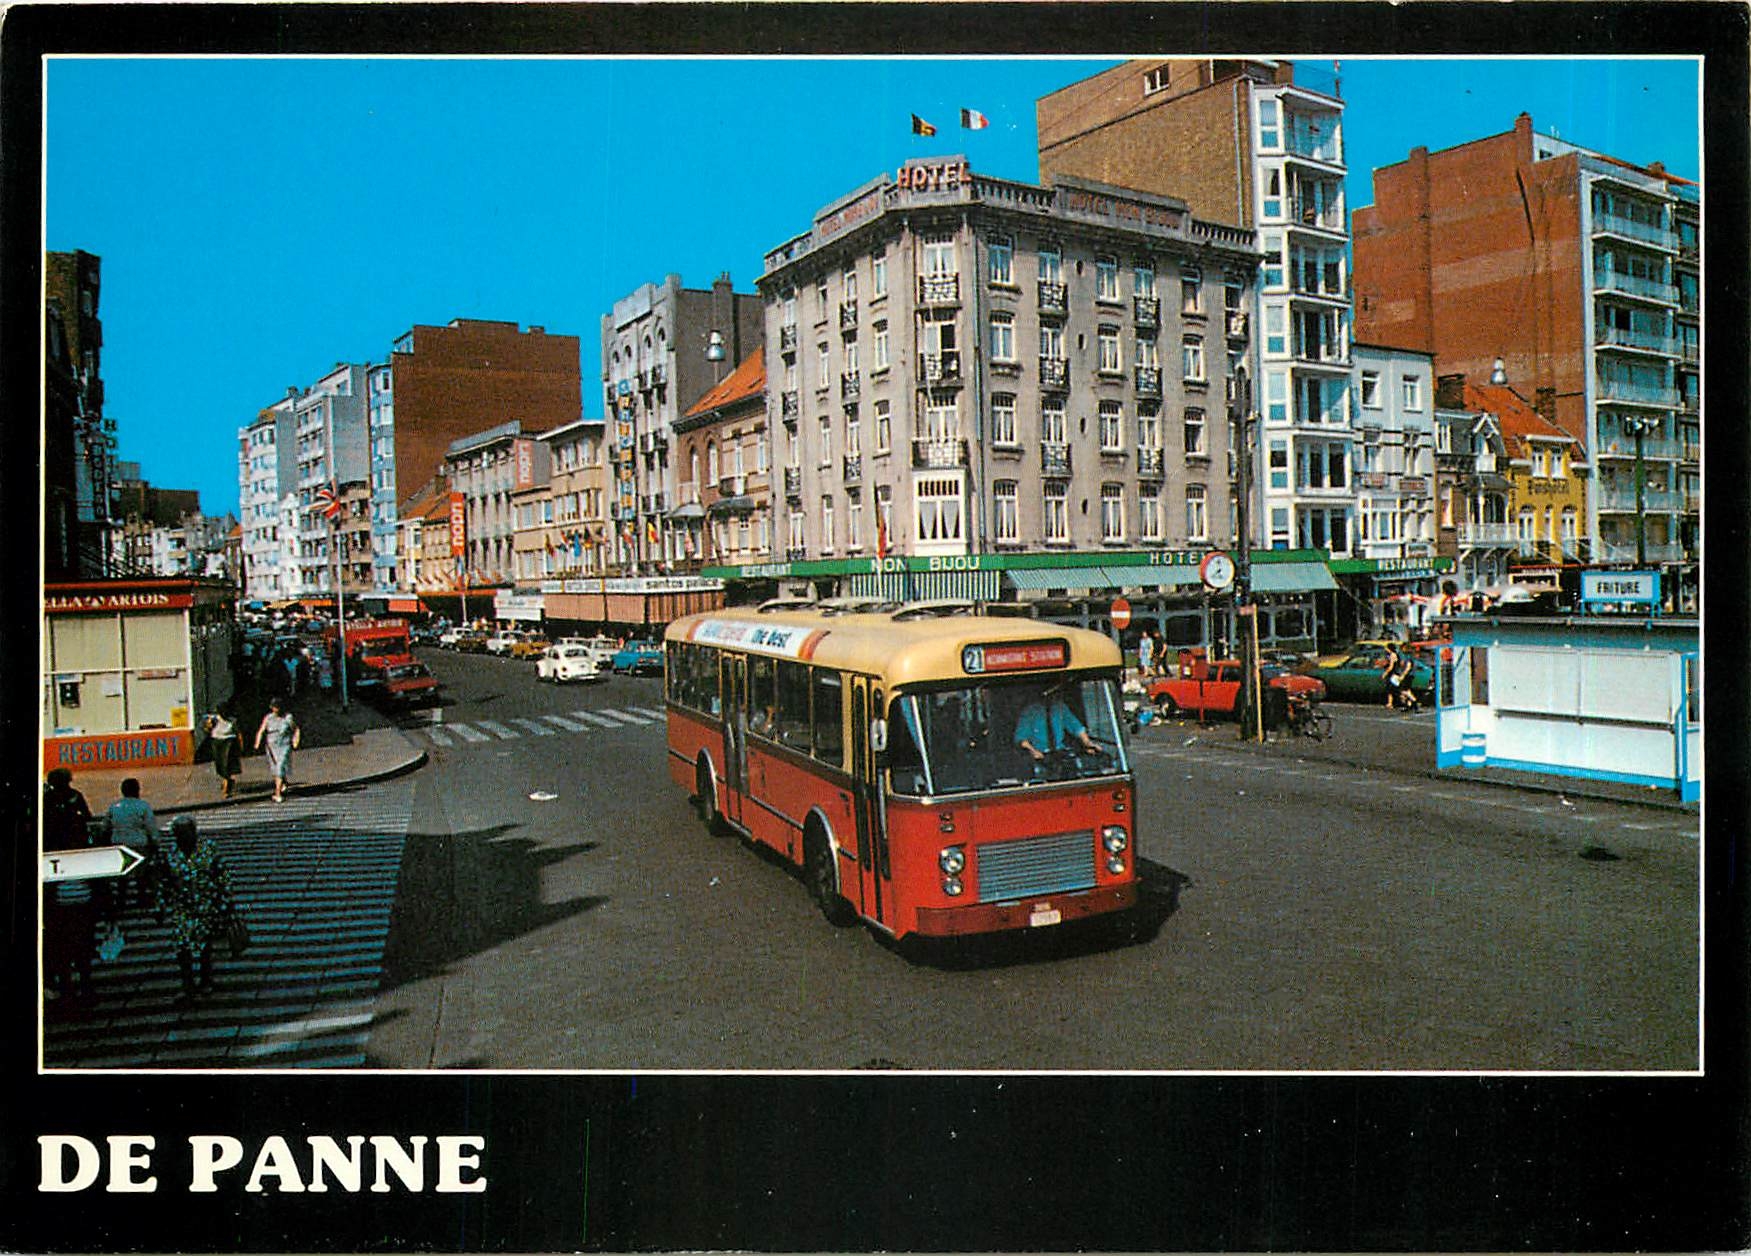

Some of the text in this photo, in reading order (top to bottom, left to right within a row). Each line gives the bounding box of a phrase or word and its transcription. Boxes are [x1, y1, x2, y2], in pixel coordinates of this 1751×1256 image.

[897, 162, 972, 191] HOTEL
[929, 556, 980, 571] BIJOU
[645, 579, 684, 589] santos
[686, 577, 720, 590] palace
[1596, 581, 1641, 594] FRITURE
[108, 593, 169, 607] ARTOIS
[966, 650, 983, 670] 21
[59, 737, 181, 765] RESTAURANT
